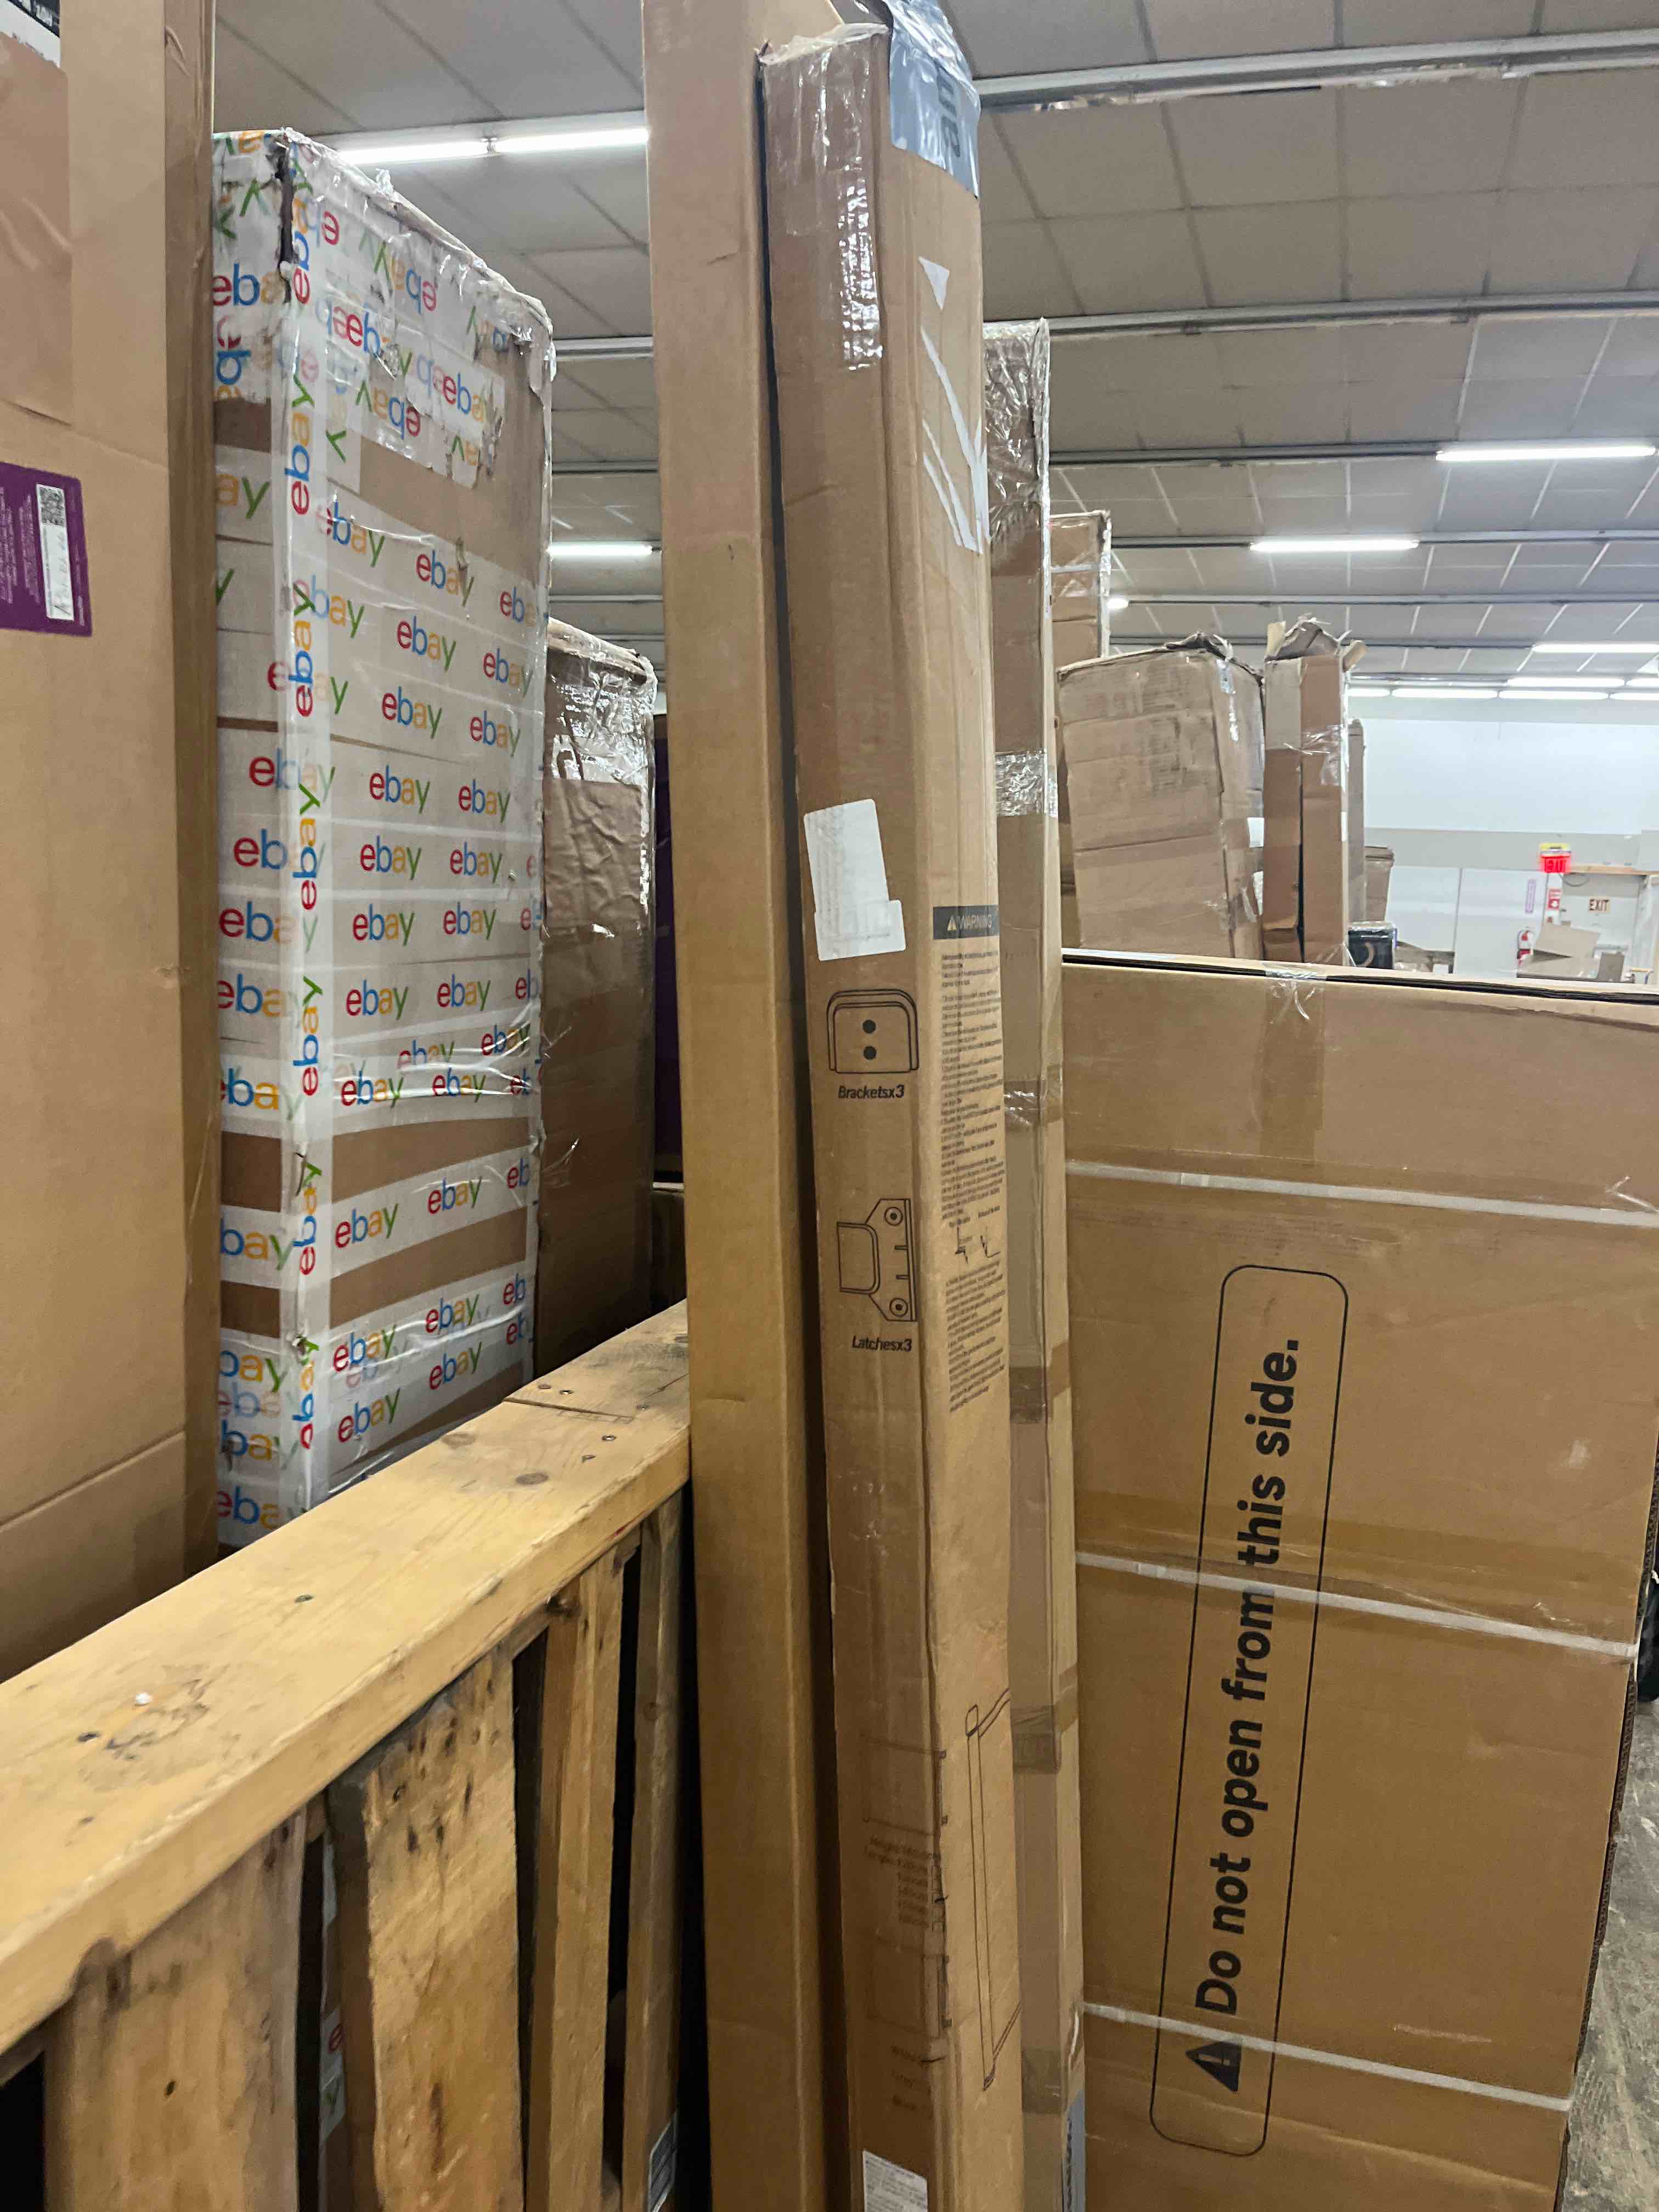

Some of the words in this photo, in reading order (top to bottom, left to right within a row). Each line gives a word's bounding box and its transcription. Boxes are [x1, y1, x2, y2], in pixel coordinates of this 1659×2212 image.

[211, 263, 281, 306] eba
[356, 381, 421, 439] ebay
[442, 373, 486, 421] eba
[285, 374, 315, 515] ebay
[215, 473, 270, 519] ay
[317, 501, 385, 567] ebay
[416, 550, 475, 607] ebay
[500, 586, 537, 627] eba
[288, 583, 315, 717] ebay
[397, 616, 456, 672] ebay
[483, 648, 533, 698] ebay
[382, 686, 442, 739] ebay
[470, 711, 521, 757] ebay
[369, 765, 430, 814] ebay
[458, 780, 510, 823] ebay
[292, 783, 320, 910] ebay
[360, 836, 421, 880] ebay
[450, 842, 502, 883] ebay
[352, 904, 414, 946] ebay
[443, 902, 496, 940] ebay
[1589, 899, 1609, 911] EXIT
[346, 980, 408, 1020] ebay
[437, 974, 490, 1012] ebay
[515, 968, 539, 1001] eb
[293, 976, 323, 1096] ebay
[341, 1070, 404, 1108] ebay
[432, 1067, 486, 1103] ebay
[427, 1176, 482, 1215] ebay
[507, 1158, 530, 1189] eb
[221, 1217, 294, 1271] bay
[335, 1204, 398, 1248] ebay
[503, 1273, 526, 1305] eb
[426, 1295, 479, 1333] ebay
[333, 1325, 396, 1372] ebay
[429, 1342, 482, 1390] ebay
[338, 1388, 400, 1443] ebay
[1244, 1339, 1299, 1457] side.
[218, 1486, 281, 1530] eba
[1237, 1474, 1285, 1567] this
[1221, 1585, 1274, 1701] from
[1221, 1719, 1268, 1838] open
[1210, 1852, 1251, 1935] not
[1195, 1950, 1241, 2016] Do
